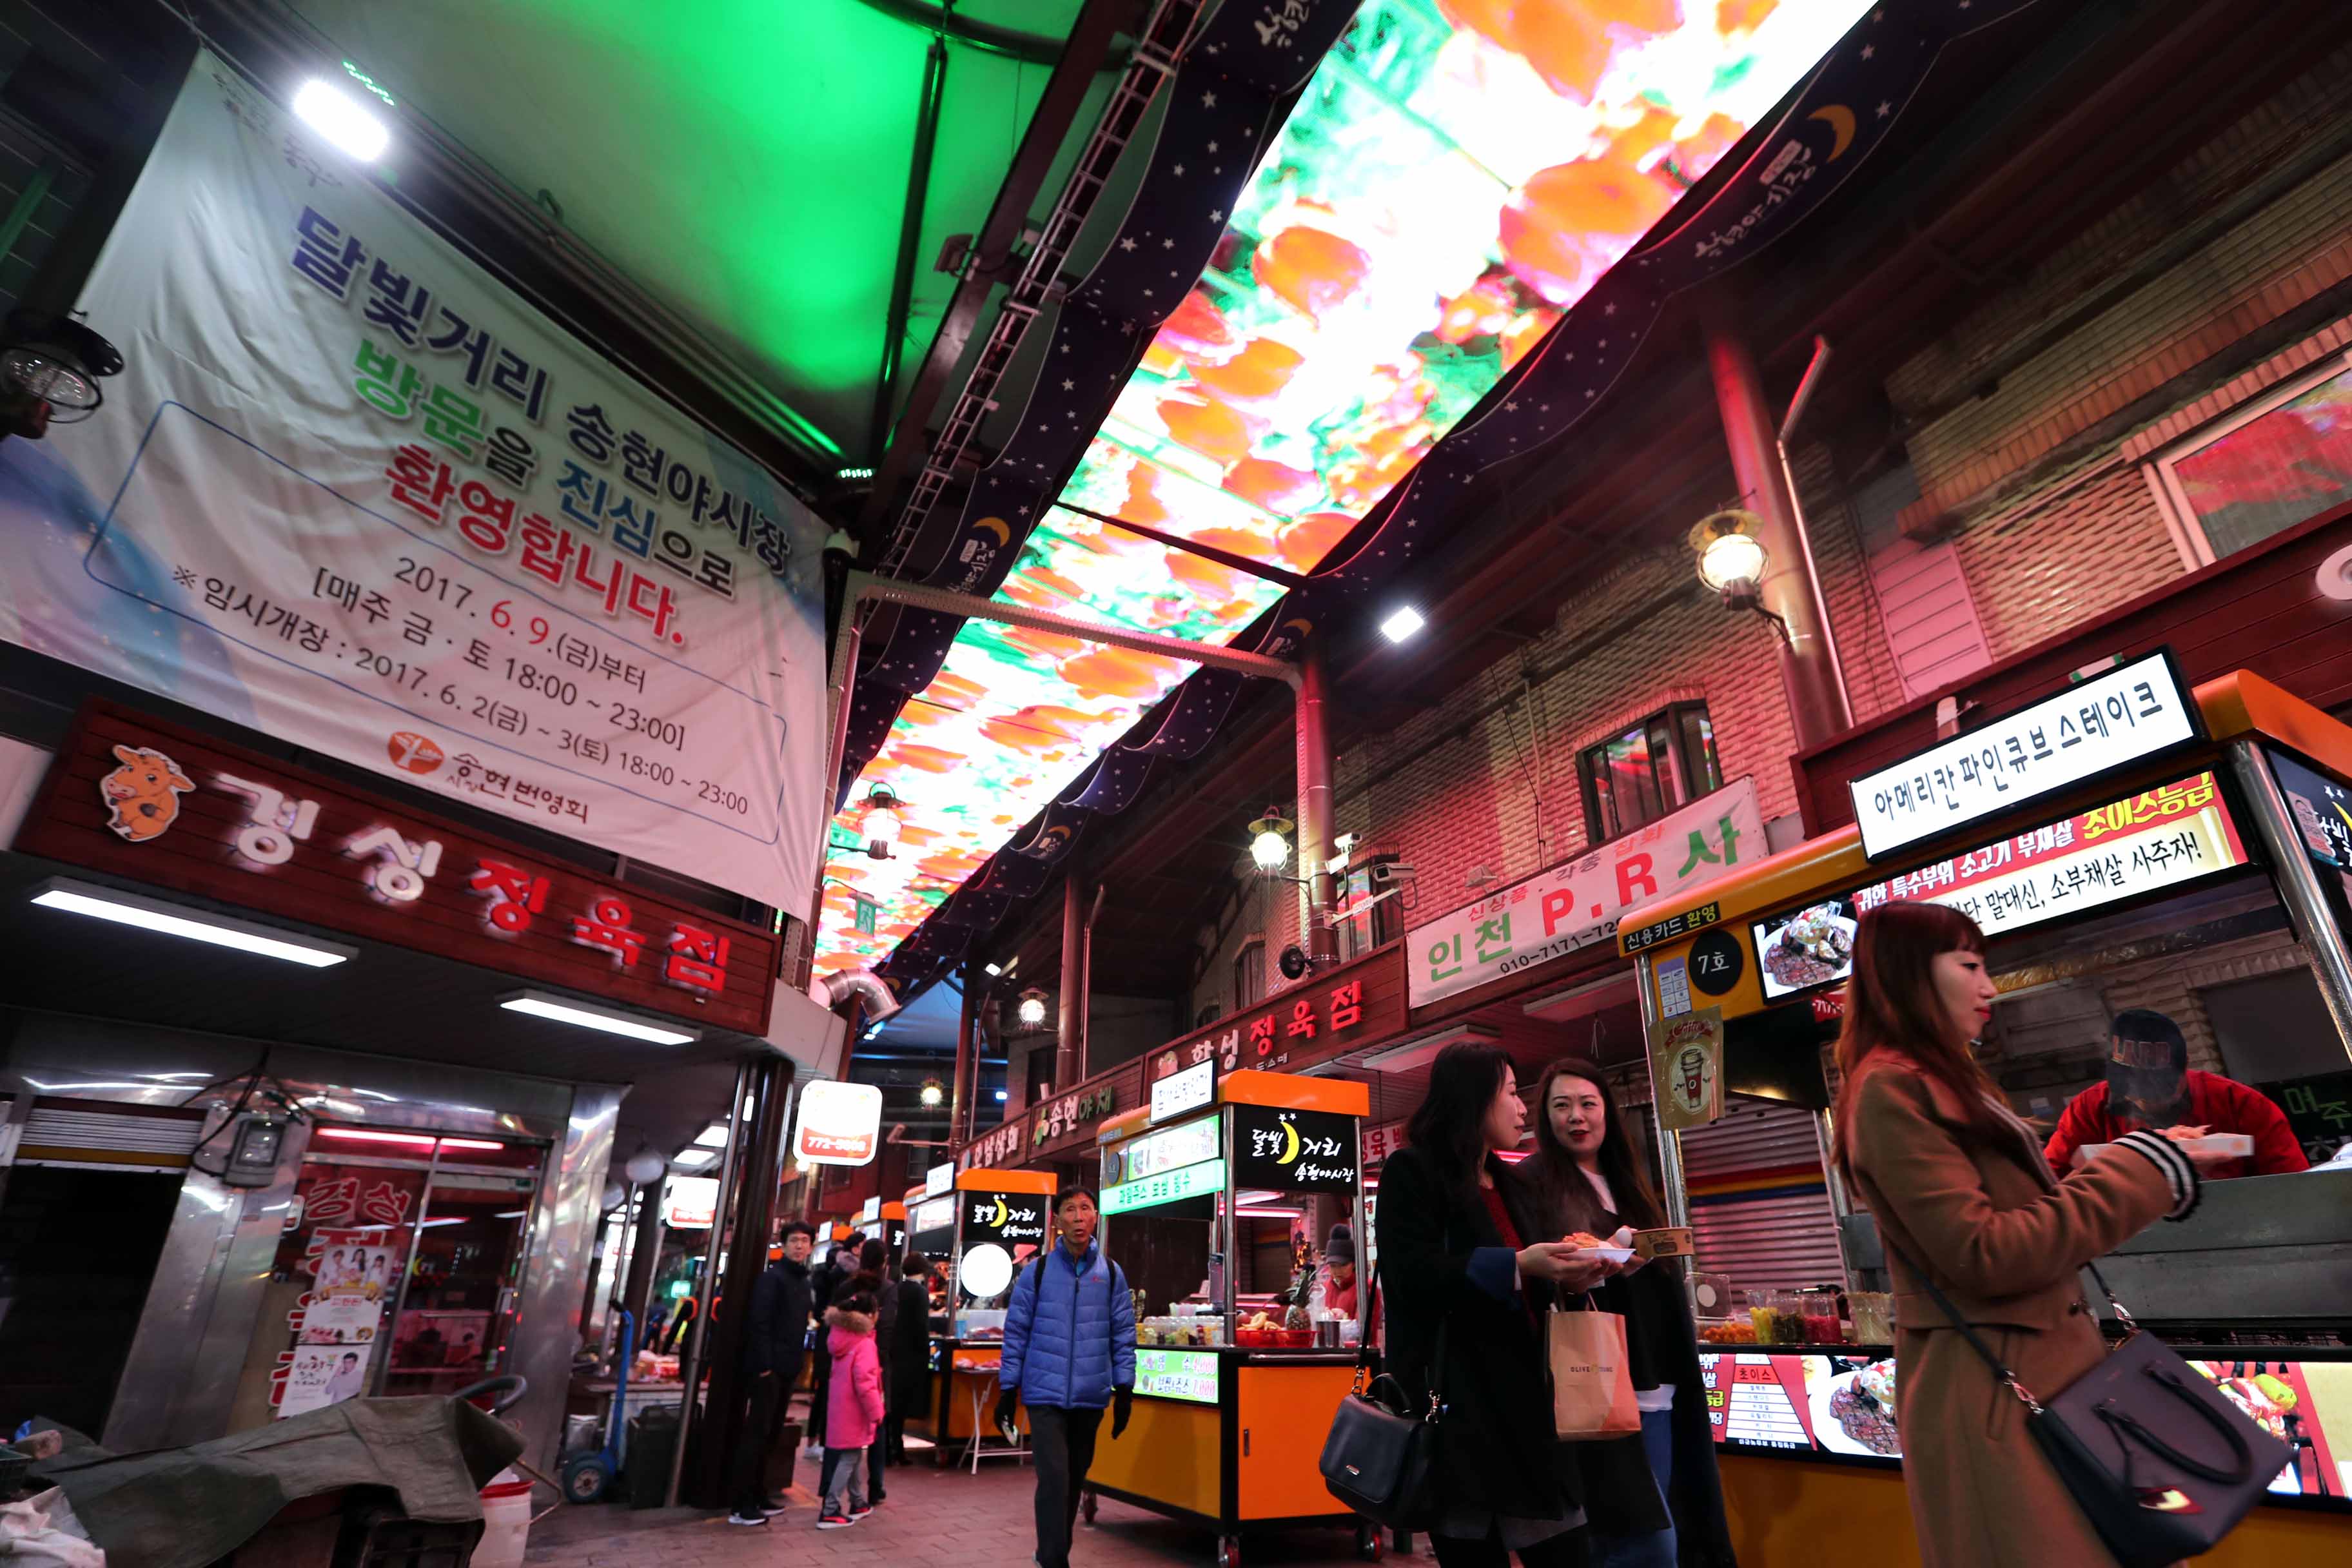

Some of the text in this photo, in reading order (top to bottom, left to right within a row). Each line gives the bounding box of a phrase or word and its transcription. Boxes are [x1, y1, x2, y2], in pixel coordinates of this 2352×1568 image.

[292, 206, 790, 573] 달빛거리 송현야시장
[355, 338, 732, 596] 방문을 진심으로
[385, 443, 683, 643] 환영합니다.
[394, 557, 476, 618] 2017.
[312, 566, 391, 625] [매주
[505, 656, 578, 706] 18:00
[608, 703, 686, 752] 23:00]
[557, 730, 609, 765] 3(토)
[619, 752, 674, 787] 18:00
[698, 780, 749, 816] 23:00
[1874, 763, 1960, 821] 아메리칸
[2060, 681, 2163, 749] 스테이크
[1468, 885, 1529, 922] 신상품
[1556, 853, 1603, 882] 각종
[1614, 823, 1666, 858] 잡화
[1959, 837, 2012, 878] 소고기
[1985, 878, 2046, 920] 말대신,
[2051, 854, 2125, 899] 소부채살
[2131, 830, 2202, 875] 사주자!
[1427, 912, 1513, 983] 인천
[1499, 917, 1623, 974] 010-7171-72
[1627, 905, 1716, 950] 신용카드 환영
[1698, 951, 1730, 975] 7호
[1293, 1162, 1355, 1183] 송현야시장
[1739, 1367, 1772, 1381] 초이스
